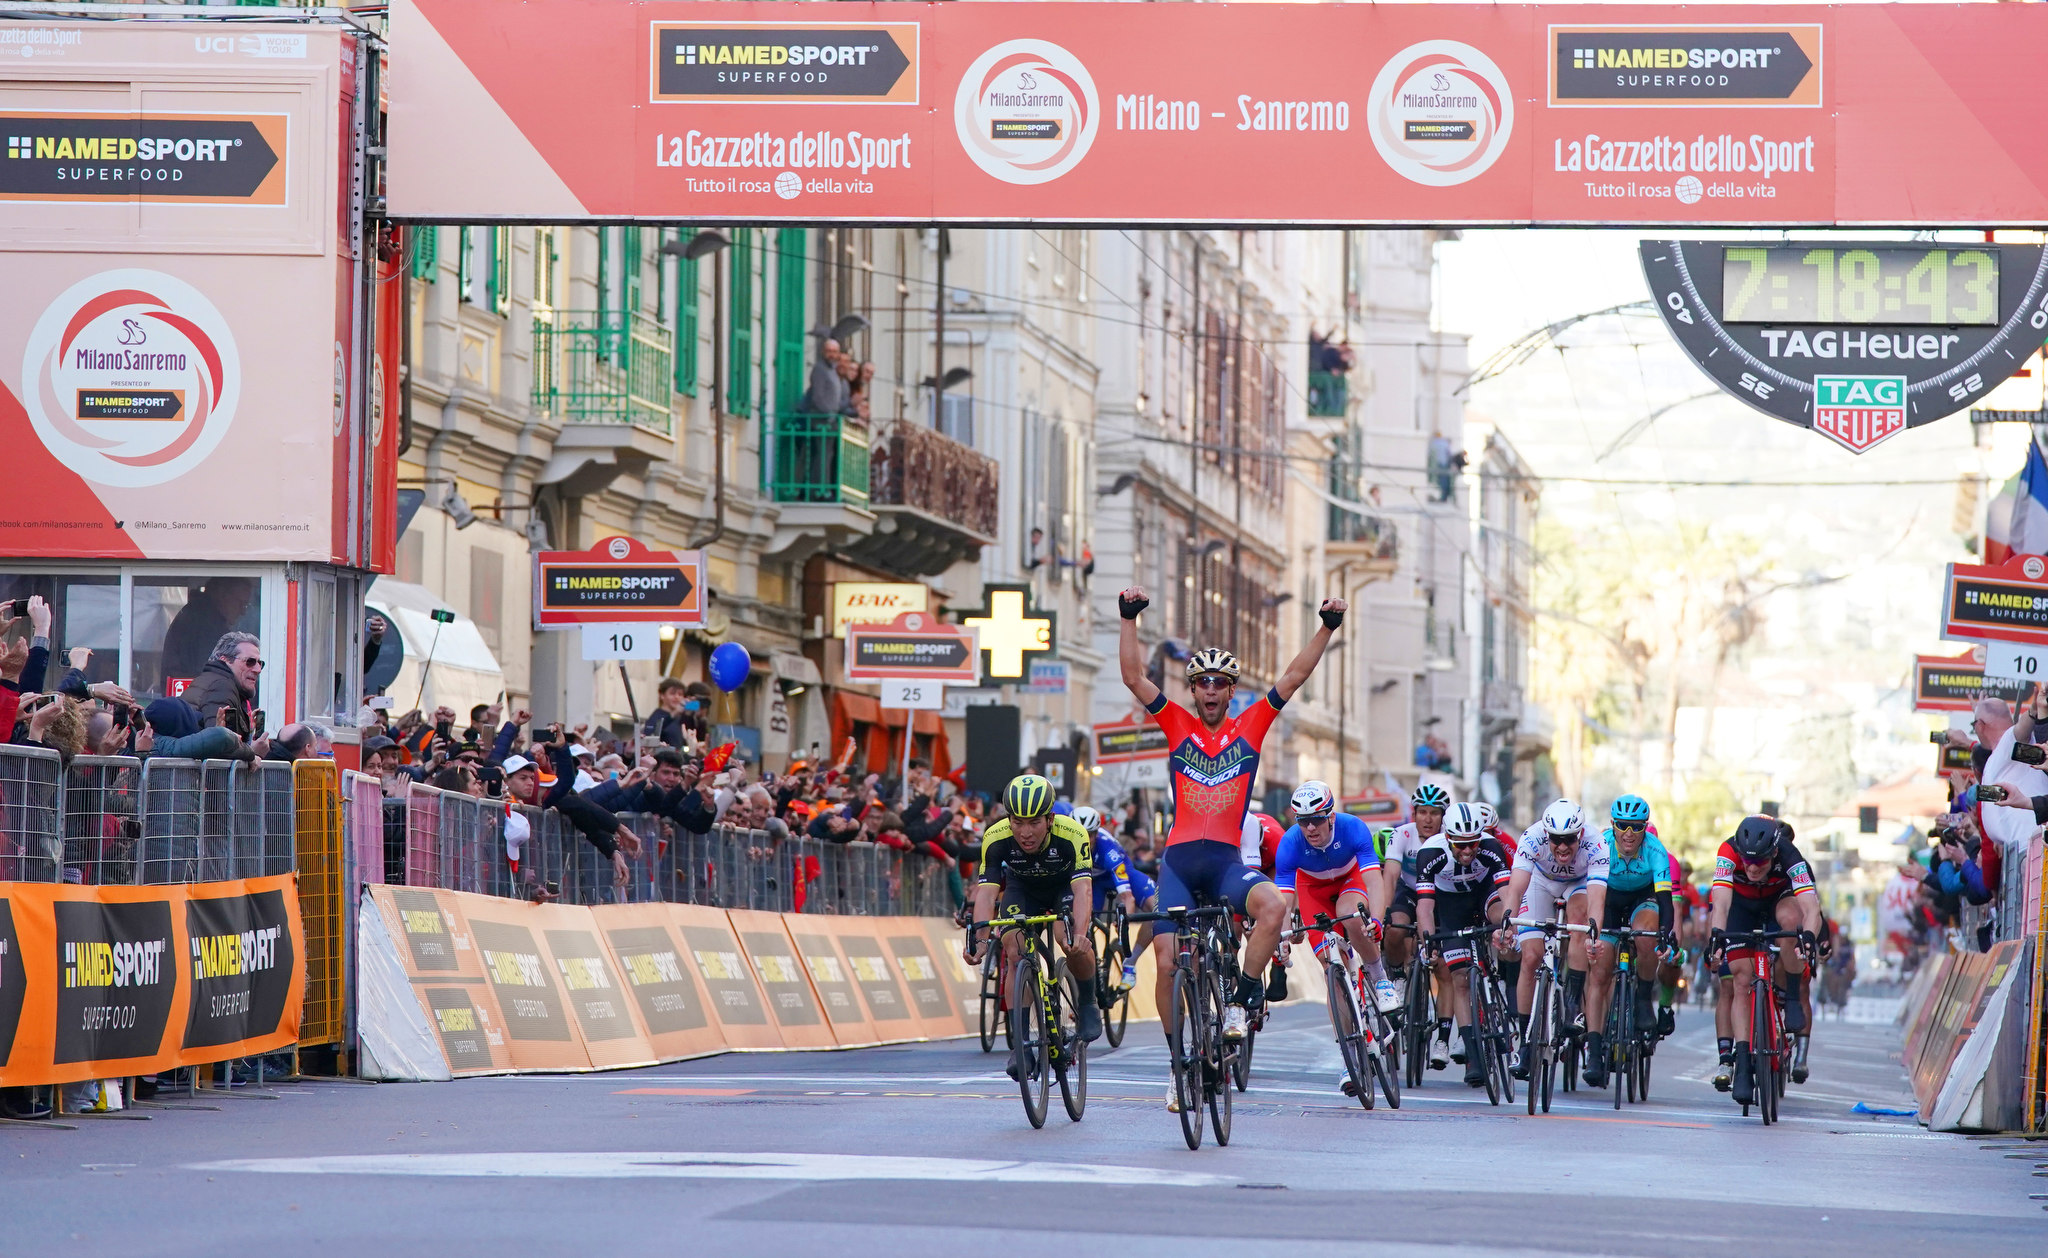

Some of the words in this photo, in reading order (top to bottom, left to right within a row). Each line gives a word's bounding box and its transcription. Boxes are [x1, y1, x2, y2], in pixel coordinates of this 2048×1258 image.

[28, 28, 52, 44] dello
[53, 28, 82, 47] Sport
[195, 37, 235, 53] UCI
[265, 38, 299, 46] WORLD
[267, 46, 292, 54] TOUR
[717, 72, 828, 84] SUPERFOOD
[1616, 75, 1730, 87] SUPERFOOD
[1115, 94, 1201, 131] Milano
[1236, 94, 1349, 132] Sanremo
[656, 133, 683, 168] La
[686, 129, 785, 168] Gazzetta
[789, 131, 844, 169] dello
[846, 131, 911, 175] Sport
[1555, 138, 1582, 172] La
[1584, 134, 1686, 172] Gazzetta
[1690, 134, 1746, 172] dello
[1748, 135, 1815, 179] Sport
[57, 166, 184, 182] SUPERFOOD
[685, 178, 727, 193] Tutto
[728, 178, 738, 193] il
[739, 181, 771, 193] rosa
[806, 178, 843, 194] della
[845, 179, 874, 194] vita
[1584, 182, 1625, 198] Tutto
[1627, 182, 1637, 198] il
[1638, 185, 1672, 198] rosa
[1707, 182, 1744, 198] della
[1746, 183, 1776, 198] vita
[1725, 248, 1994, 323] 7:18:43
[1667, 292, 1694, 325] 40
[1738, 372, 1775, 400] 35
[1822, 381, 1898, 403] TAG
[1948, 372, 1984, 402] 25
[1819, 410, 1900, 448] HEUER
[134, 521, 207, 531] @Milano_Sanremo
[221, 522, 310, 533] www.milanosanremo.it
[580, 592, 646, 600] SUPERFOOD
[847, 594, 900, 606] BAR
[609, 633, 633, 652] 10
[881, 655, 934, 663] SUPERFOOD
[2013, 655, 2038, 675] 10
[902, 687, 922, 701] 25
[1184, 742, 1242, 774] BAHRAIN
[1182, 763, 1242, 787] MERIDA
[1426, 853, 1446, 870] GIANT
[1481, 848, 1502, 862] GIANT
[1550, 865, 1575, 875] UAE
[82, 1005, 137, 1031] SUPERFOOD
